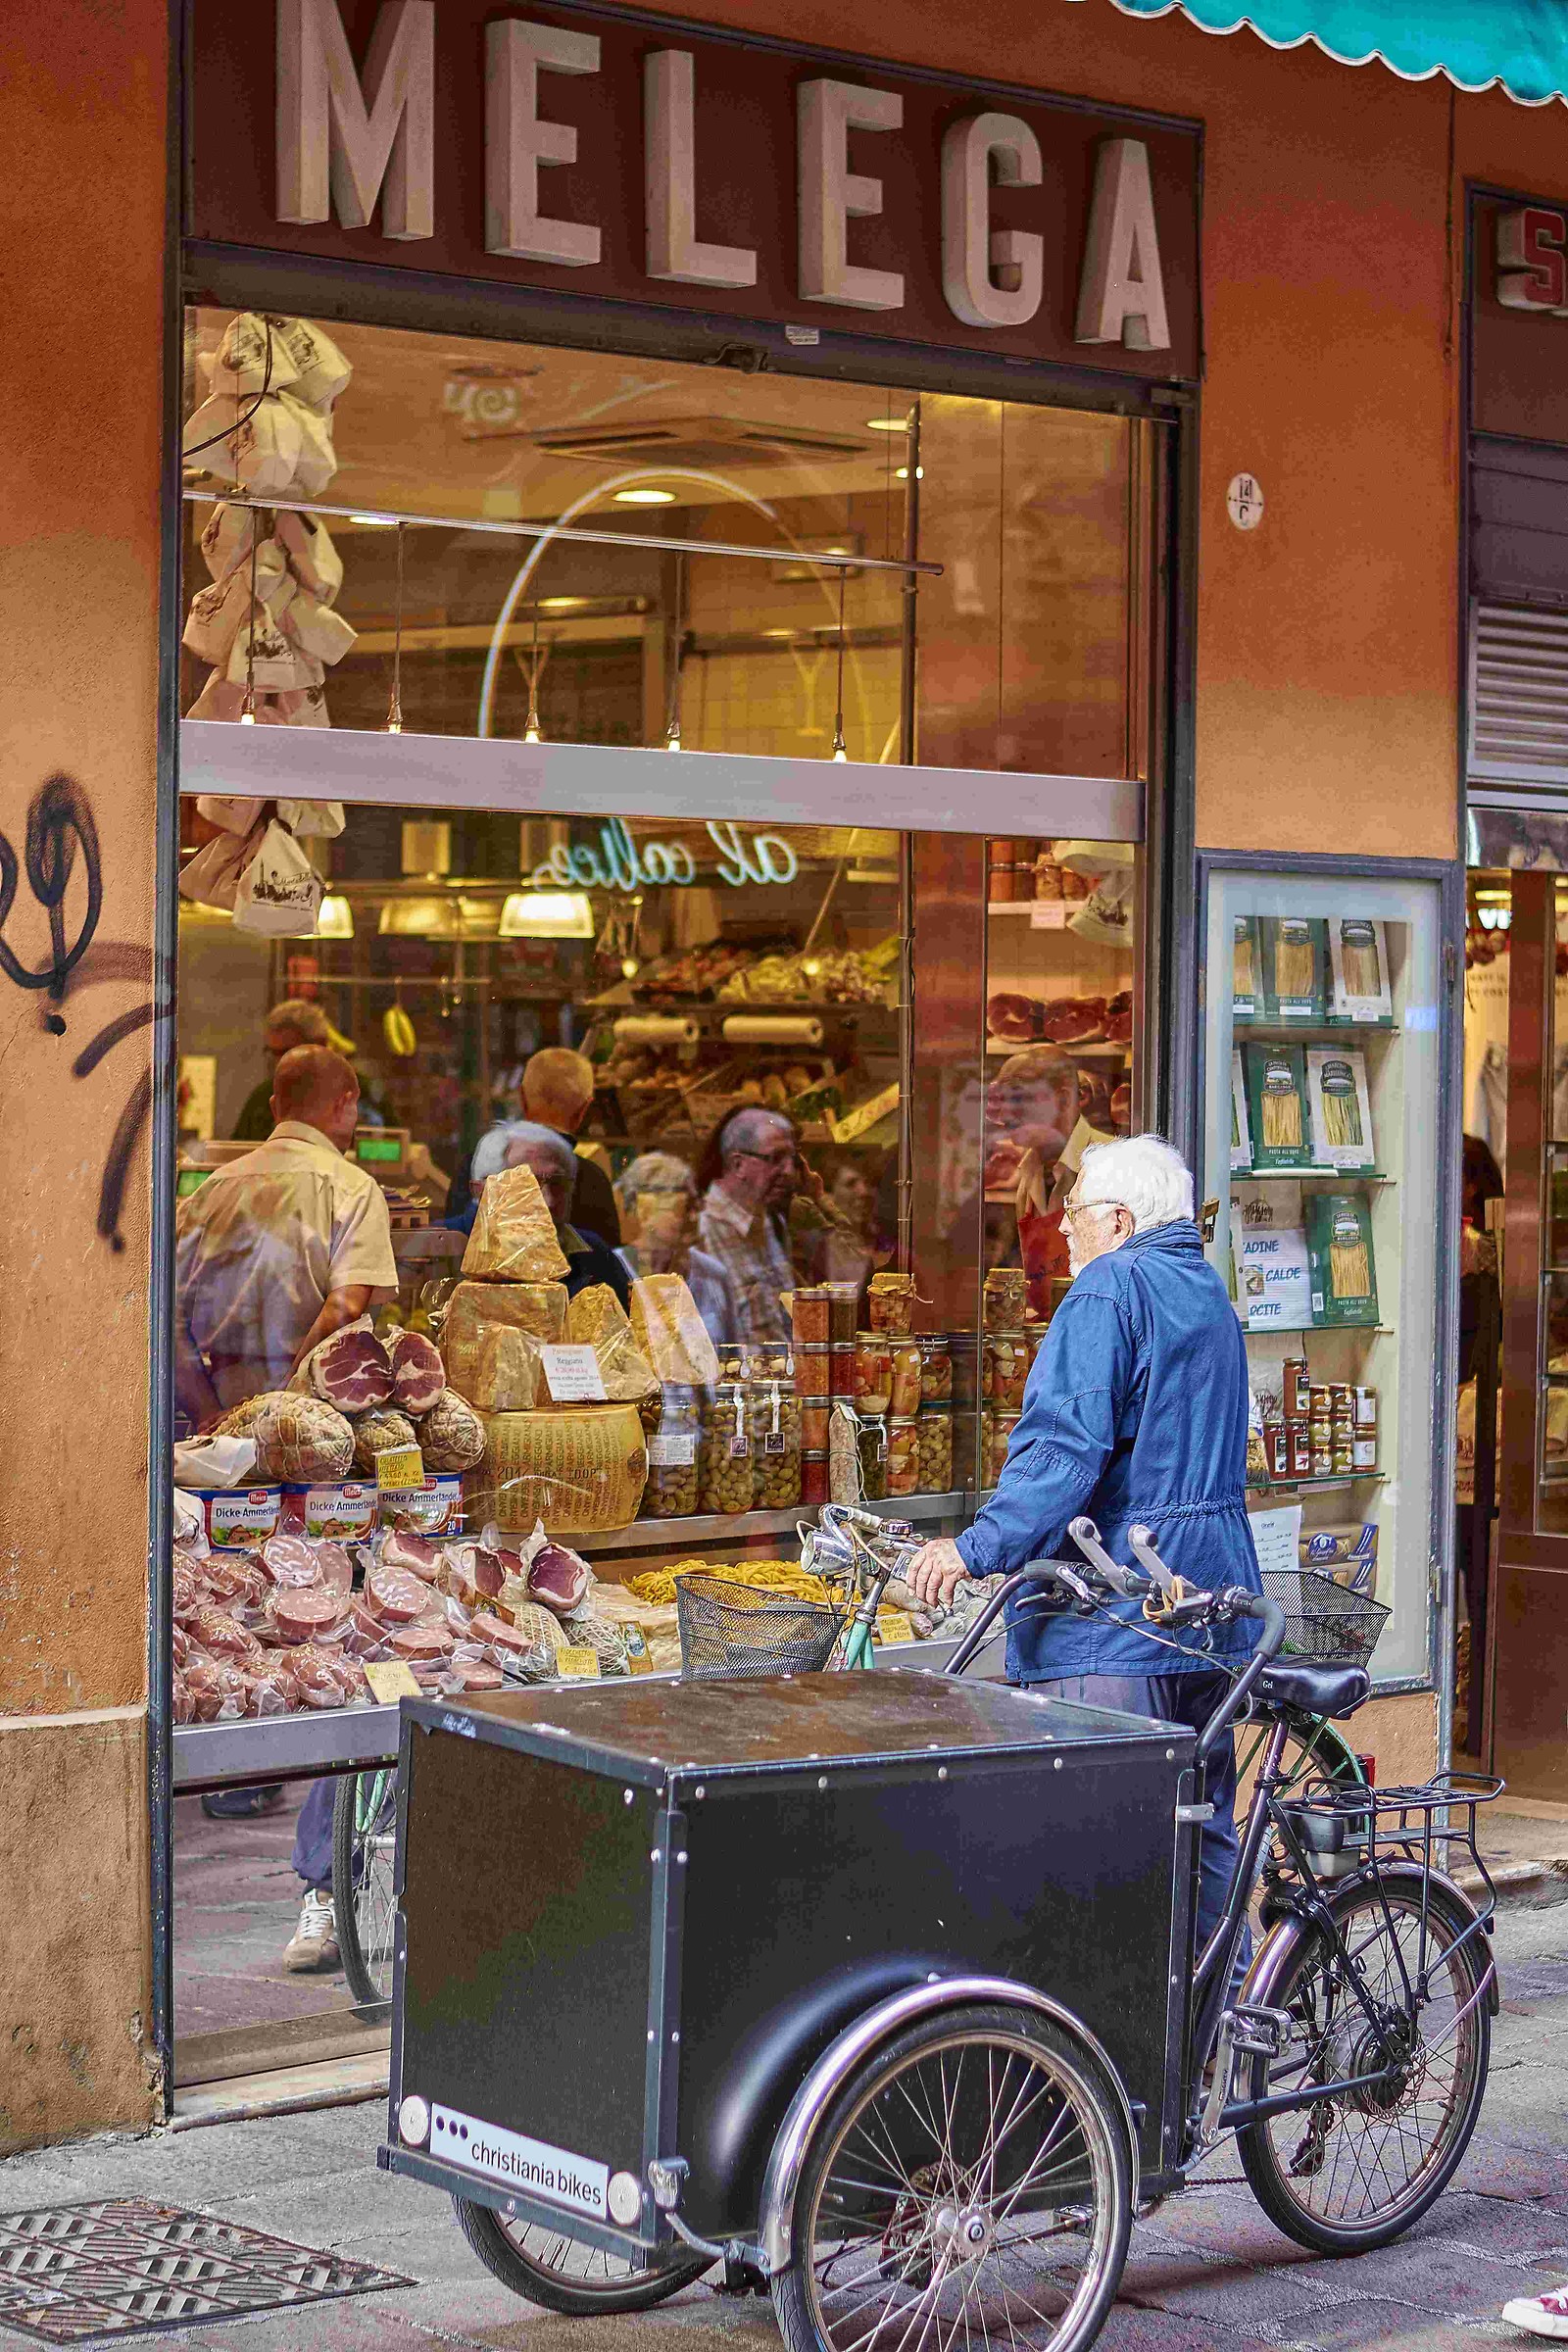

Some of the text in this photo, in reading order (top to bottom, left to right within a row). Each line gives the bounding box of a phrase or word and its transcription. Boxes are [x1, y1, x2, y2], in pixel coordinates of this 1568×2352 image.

[275, 0, 1171, 351] MELEGA
[1496, 207, 1568, 316] S
[1243, 1240, 1279, 1253] ADINE
[1265, 1267, 1300, 1281] CALDE
[382, 1493, 407, 1502] Dicke
[217, 1507, 241, 1517] Dicke
[310, 1500, 334, 1512] Dicke
[447, 1521, 456, 1531] 20
[471, 2139, 601, 2205] christiania bikes
